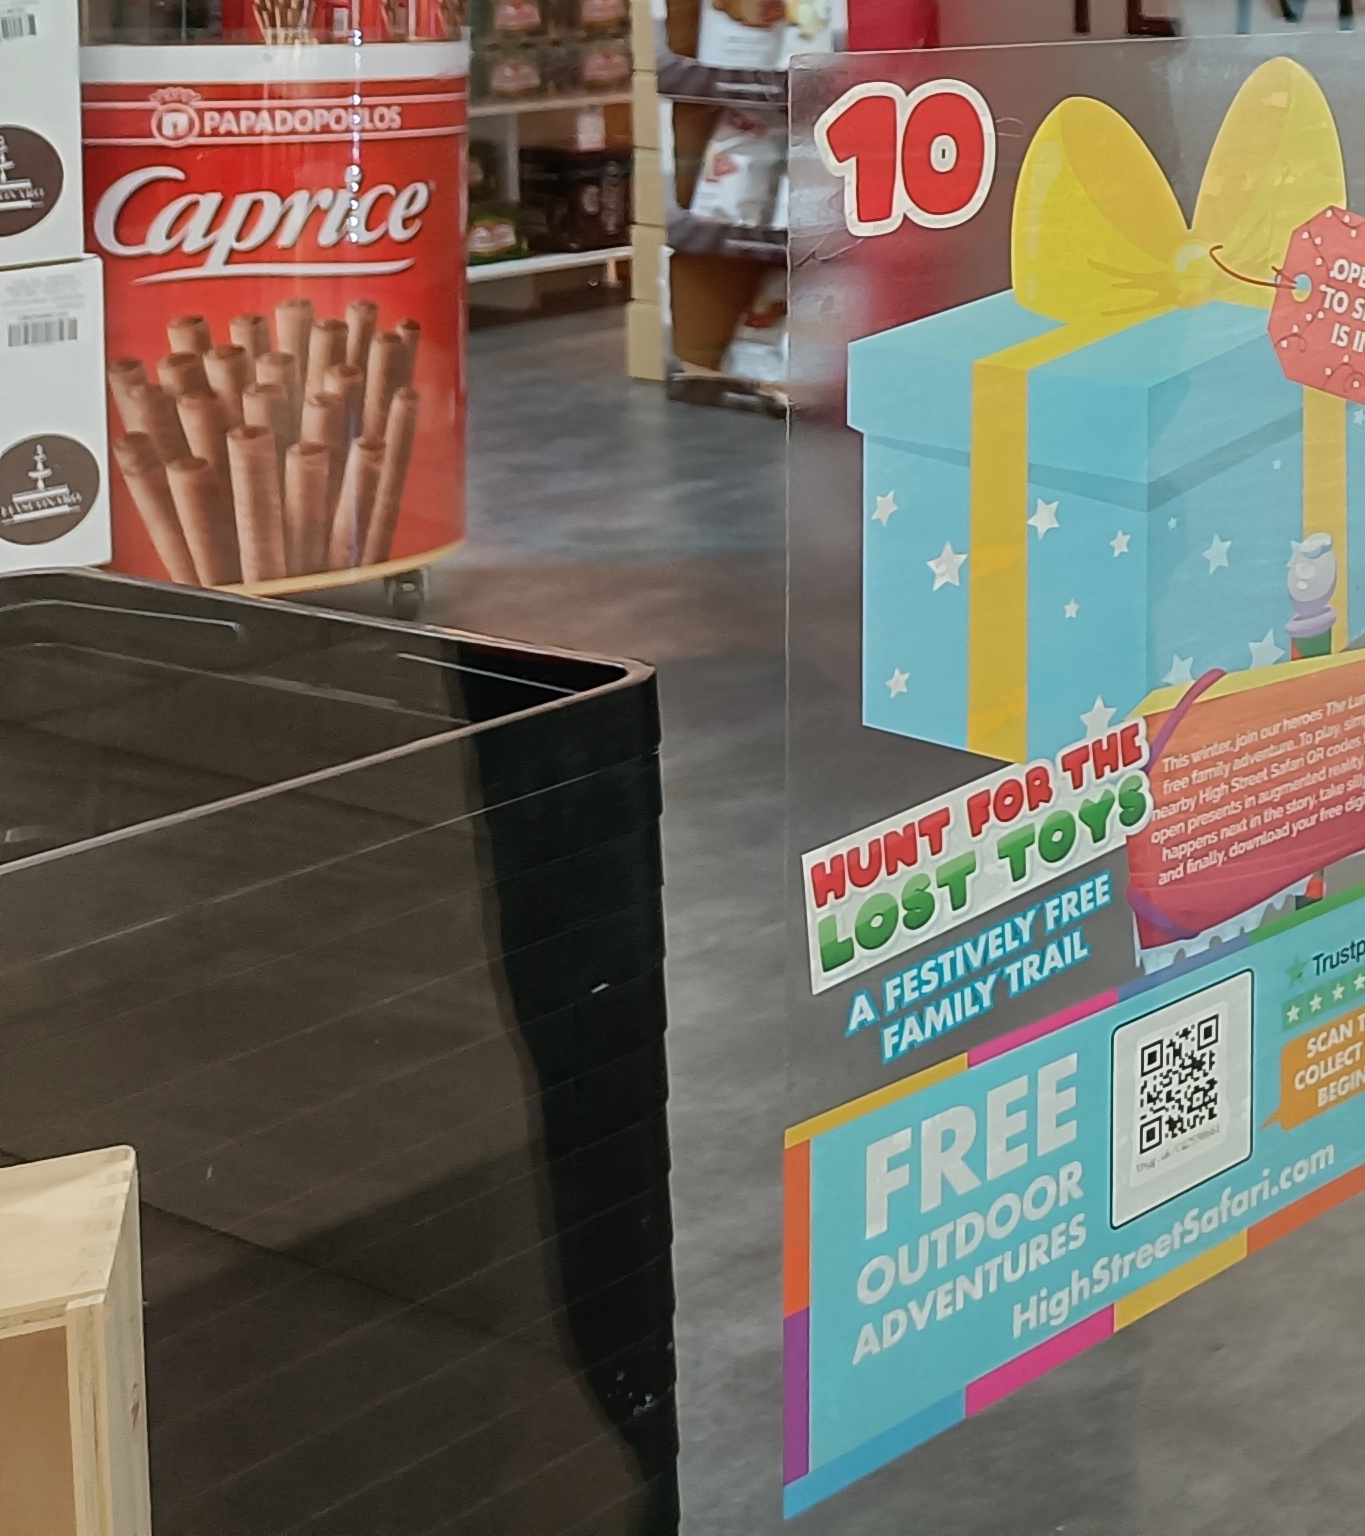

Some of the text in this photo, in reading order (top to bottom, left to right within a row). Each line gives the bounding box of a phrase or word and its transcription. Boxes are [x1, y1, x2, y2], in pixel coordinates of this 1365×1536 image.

[203, 106, 402, 136] PAPADOPOULOS
[817, 81, 994, 234] 10
[94, 165, 430, 271] Caprice
[1321, 285, 1349, 314] TO
[1330, 322, 1351, 347] IS
[1151, 796, 1198, 821] nearby
[1199, 782, 1229, 806] High
[1231, 768, 1269, 793] Street
[1270, 751, 1305, 779] Safari
[1306, 746, 1325, 765] QR
[1326, 735, 1362, 758] codes
[1162, 752, 1190, 773] This
[1234, 730, 1258, 752] join
[1260, 724, 1281, 740] our
[1283, 708, 1324, 732] heroes
[1163, 775, 1190, 796] free
[1191, 760, 1232, 785] family
[1299, 731, 1313, 747] To
[811, 721, 1144, 909] HUNT FOR THE
[1151, 821, 1186, 844] open
[1187, 800, 1242, 834] presents
[1244, 793, 1256, 809] in
[1257, 767, 1327, 806] augmented
[1157, 863, 1185, 886] and
[1228, 820, 1290, 858] download
[1291, 813, 1319, 838] your
[1320, 804, 1343, 822] free
[1162, 831, 1219, 862] happens
[1220, 819, 1248, 840] next
[1249, 813, 1262, 830] in
[1263, 805, 1284, 823] the
[1319, 782, 1345, 802] take
[817, 773, 1147, 973] LOST TOYS
[848, 874, 1112, 1032] A FESTIVELY FREE
[883, 929, 1090, 1060] FAMILY TRAIL
[1294, 1041, 1363, 1091] COLLECT
[1306, 1018, 1354, 1059] SCAN
[865, 1052, 1078, 1241] FREE
[856, 1160, 1084, 1305] OUTDOOR
[1012, 1143, 1336, 1340] HighStreetSafari.com
[852, 1212, 1087, 1366] ADVENTURES
